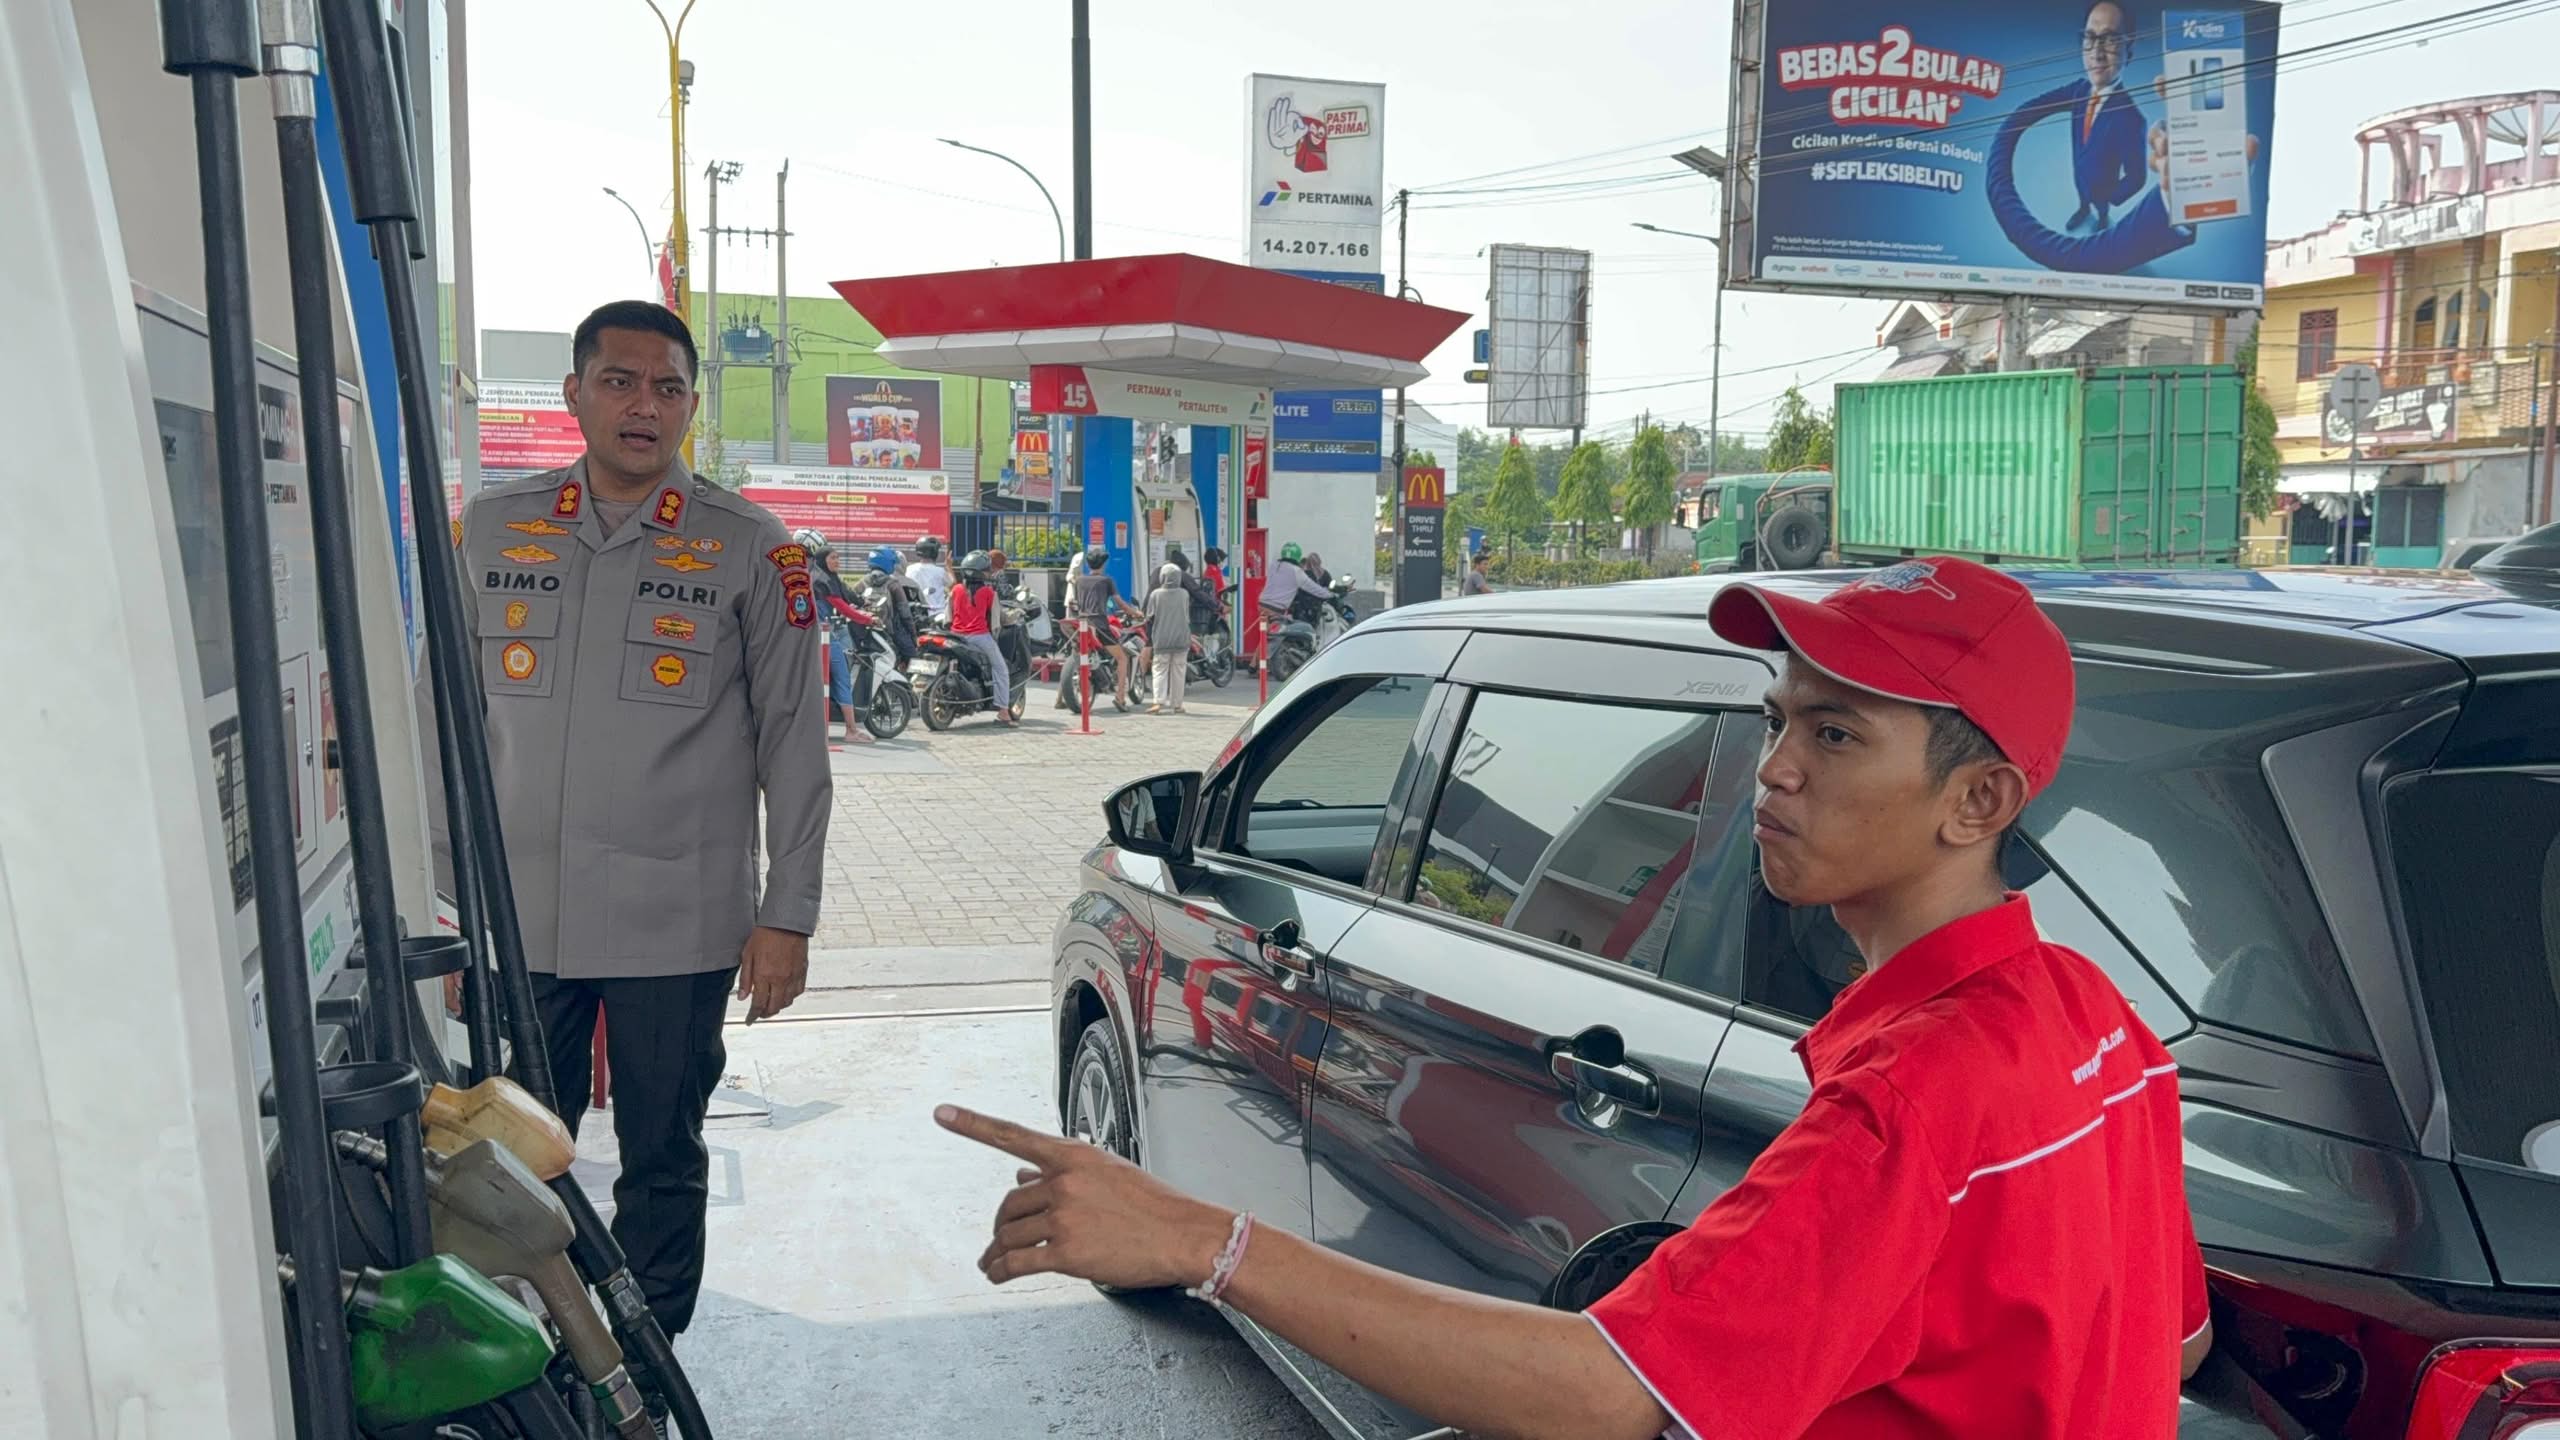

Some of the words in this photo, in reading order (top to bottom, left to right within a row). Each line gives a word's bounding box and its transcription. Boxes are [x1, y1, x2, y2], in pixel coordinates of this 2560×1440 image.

[1780, 44, 1877, 83] BEBAS
[1879, 28, 1910, 77] 2
[1912, 49, 2000, 92] BULAN
[1326, 111, 1357, 123] PASTI
[1327, 122, 1367, 135] PRIMA!
[1792, 135, 1838, 149] Cicilan
[1896, 137, 1938, 154] Berani
[1942, 144, 1983, 163] Diadu!
[1811, 161, 1963, 191] #SEFLEKSIBELITU
[1298, 192, 1374, 206] PERTAMINA
[1263, 239, 1369, 257] 14.207.166
[1064, 383, 1087, 408] 15
[1127, 383, 1172, 397] PERTAMAX
[1178, 401, 1219, 414] PERTALITE
[1408, 515, 1436, 525] DRIVE
[1411, 524, 1433, 533] THRU
[1404, 549, 1437, 558] MASUK
[485, 571, 560, 592] BIMO
[638, 581, 717, 607] POLRI
[1672, 680, 1749, 696] XENIA
